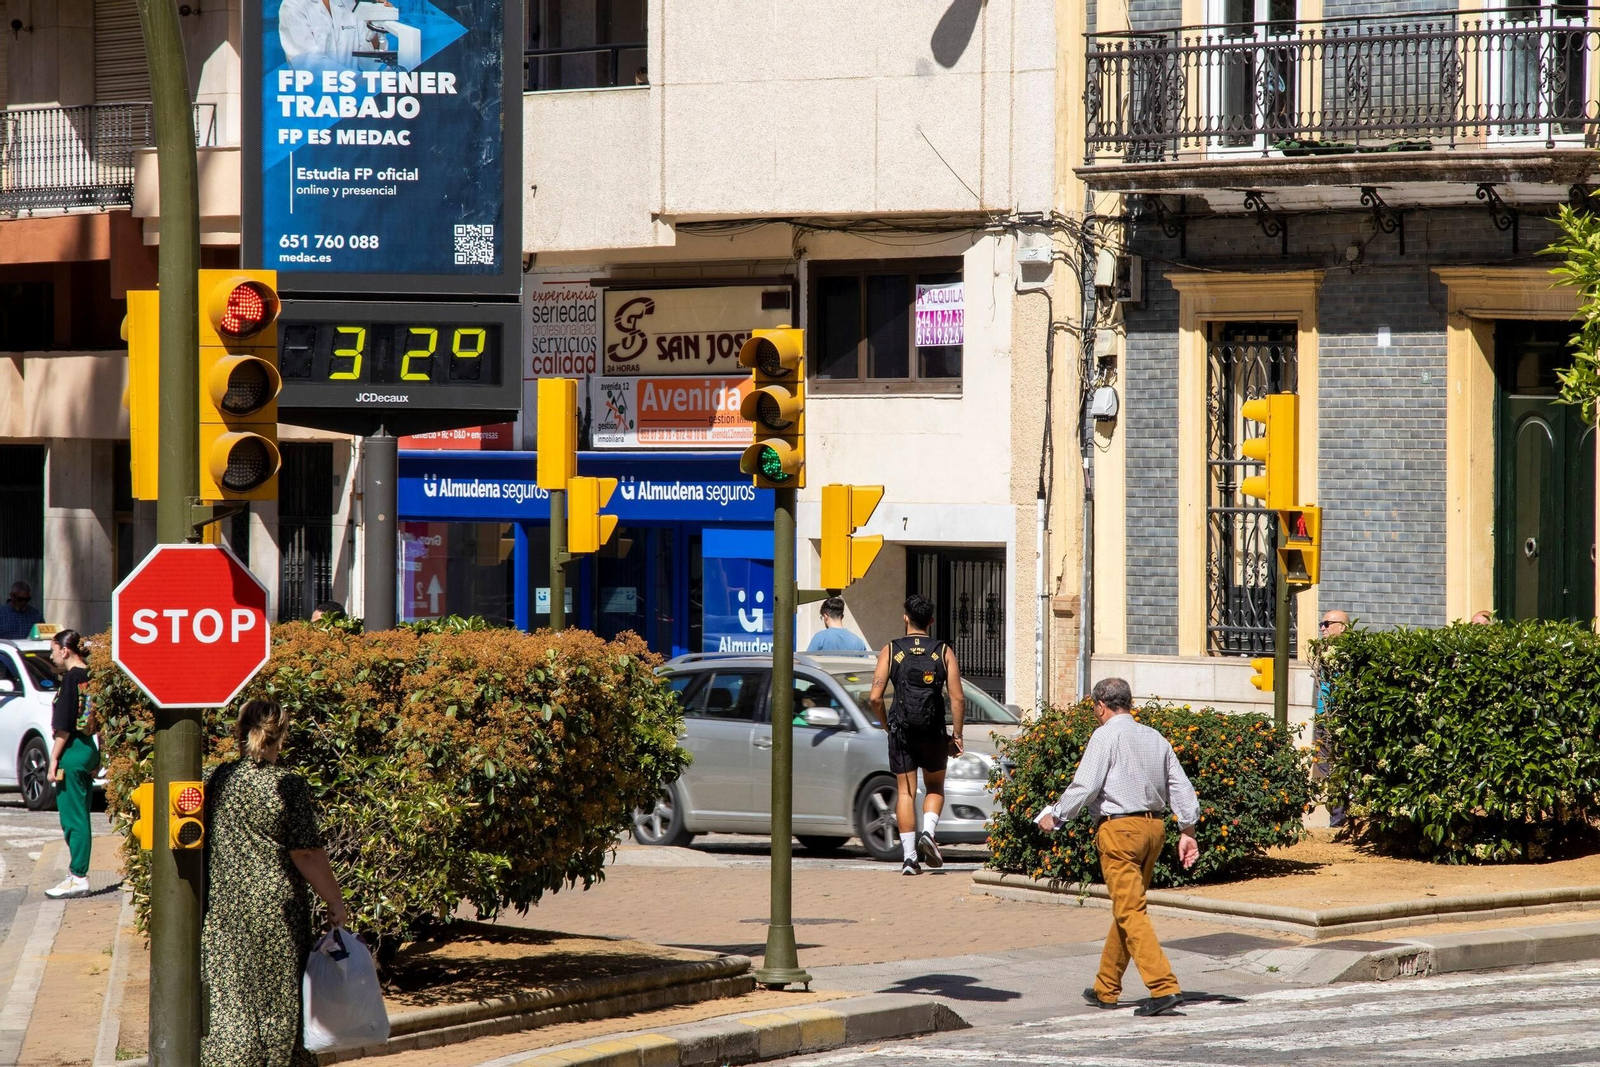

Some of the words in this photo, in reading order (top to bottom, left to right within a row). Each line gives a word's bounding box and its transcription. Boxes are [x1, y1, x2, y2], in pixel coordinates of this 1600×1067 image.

[278, 70, 314, 93] FP
[322, 71, 357, 94] ES
[362, 71, 458, 95] TENER
[277, 95, 421, 119] TRABAJO
[278, 129, 303, 145] FP
[307, 130, 332, 145] ES
[336, 129, 412, 146] MEDAC
[296, 166, 351, 181] Estudia
[354, 168, 374, 181] FP
[376, 167, 419, 181] oficial
[296, 184, 330, 196] online
[332, 187, 340, 198] y
[341, 185, 397, 198] presencial
[279, 234, 309, 249] 651
[314, 235, 345, 249] 760
[348, 235, 380, 249] 088
[279, 252, 332, 263] medac.es
[532, 286, 598, 306] experiencia
[927, 288, 964, 304] ALQUILA
[532, 299, 597, 324] seriedad
[532, 322, 597, 338] profesionalidad
[532, 335, 597, 354] servicios
[656, 335, 700, 363] SAN
[706, 333, 752, 365] JOS
[532, 350, 597, 375] calidad
[617, 365, 640, 373] HORAS
[600, 382, 622, 391] avenida
[622, 382, 630, 391] 12
[355, 392, 409, 404] JCDecaux
[641, 380, 742, 412] Avenida
[708, 412, 735, 427] gestión
[471, 431, 499, 439] empresas
[439, 478, 500, 498] Almudena
[502, 483, 549, 504] seguros
[637, 480, 704, 500] Almudena
[705, 485, 755, 506] seguros
[902, 516, 909, 531] 7
[129, 608, 257, 645] STOP
